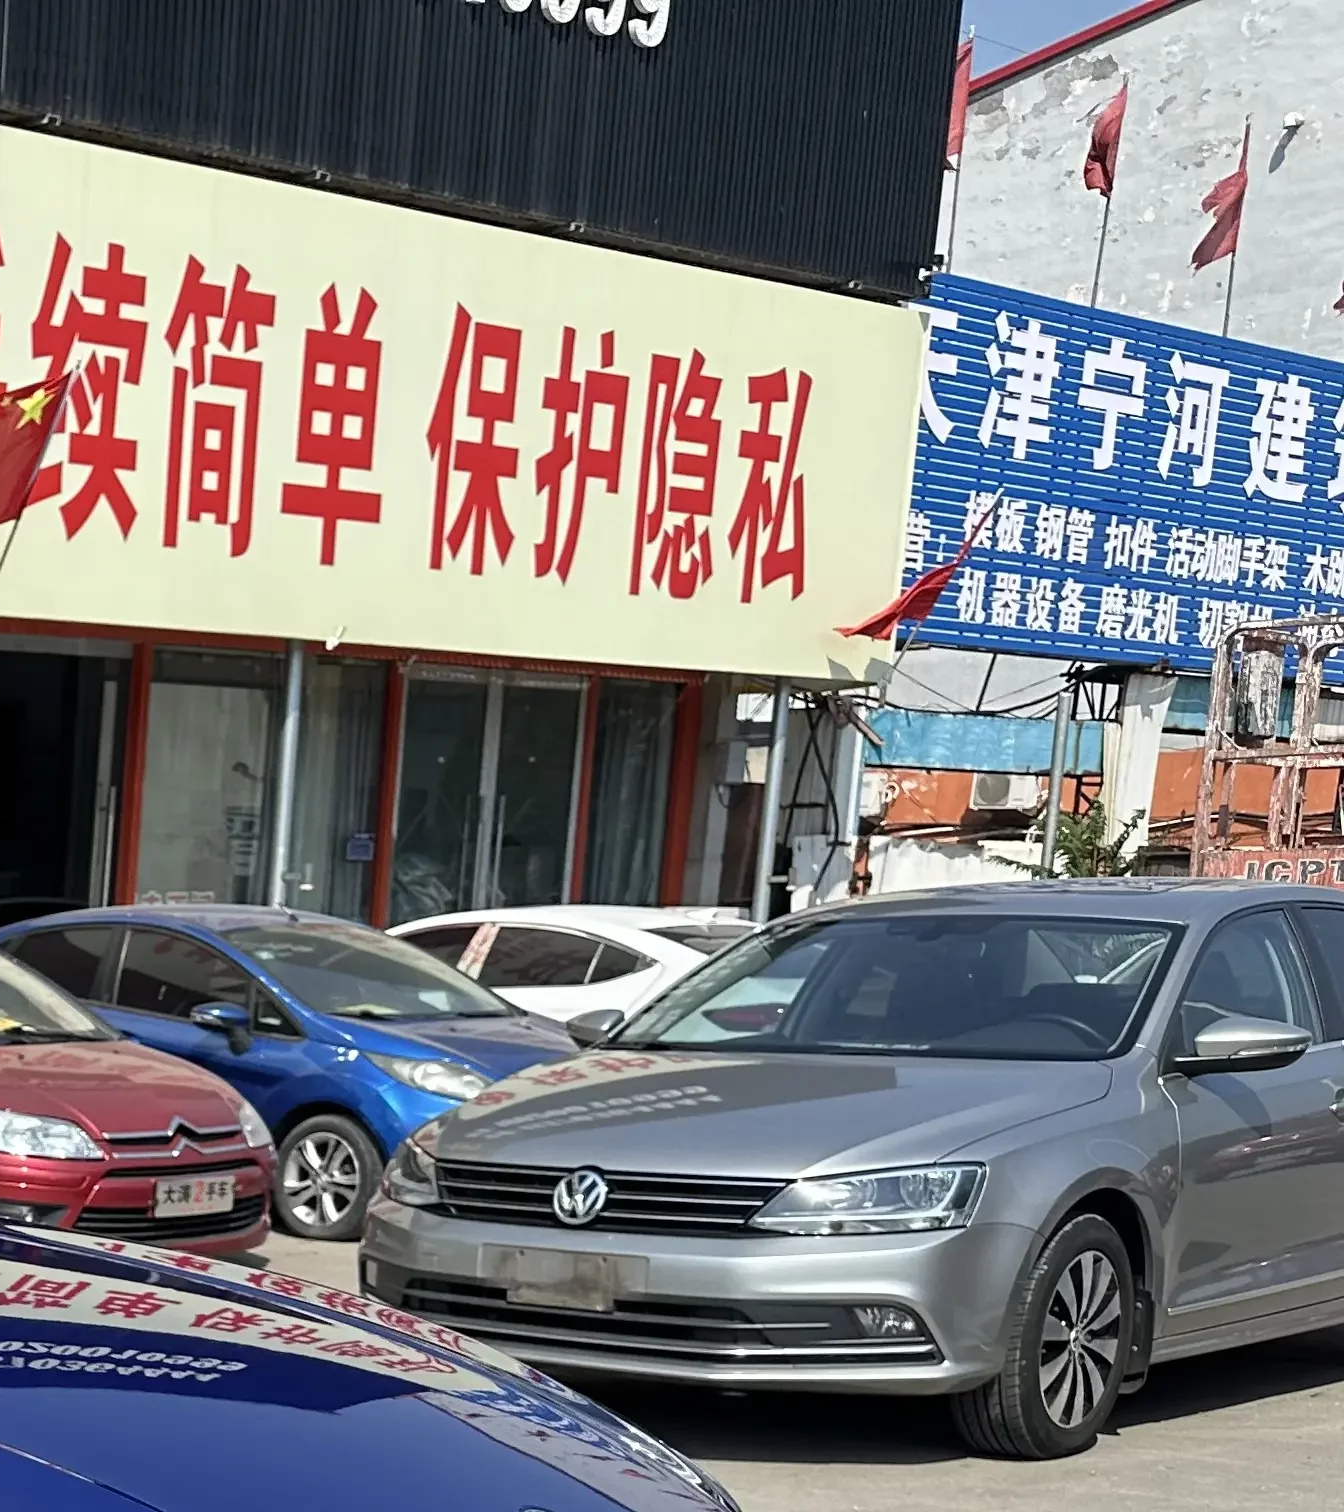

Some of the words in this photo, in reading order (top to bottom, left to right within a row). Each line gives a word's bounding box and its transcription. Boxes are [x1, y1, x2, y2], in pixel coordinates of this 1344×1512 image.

[425, 302, 814, 604] 保护隐私
[910, 302, 1344, 516] 天津宁河建
[957, 565, 1087, 635] 机器设备
[1095, 584, 1179, 644] 磨光机
[1034, 503, 1096, 564] 钢管
[1103, 518, 1158, 575] 扣件
[1165, 528, 1290, 592] 活动脚手架
